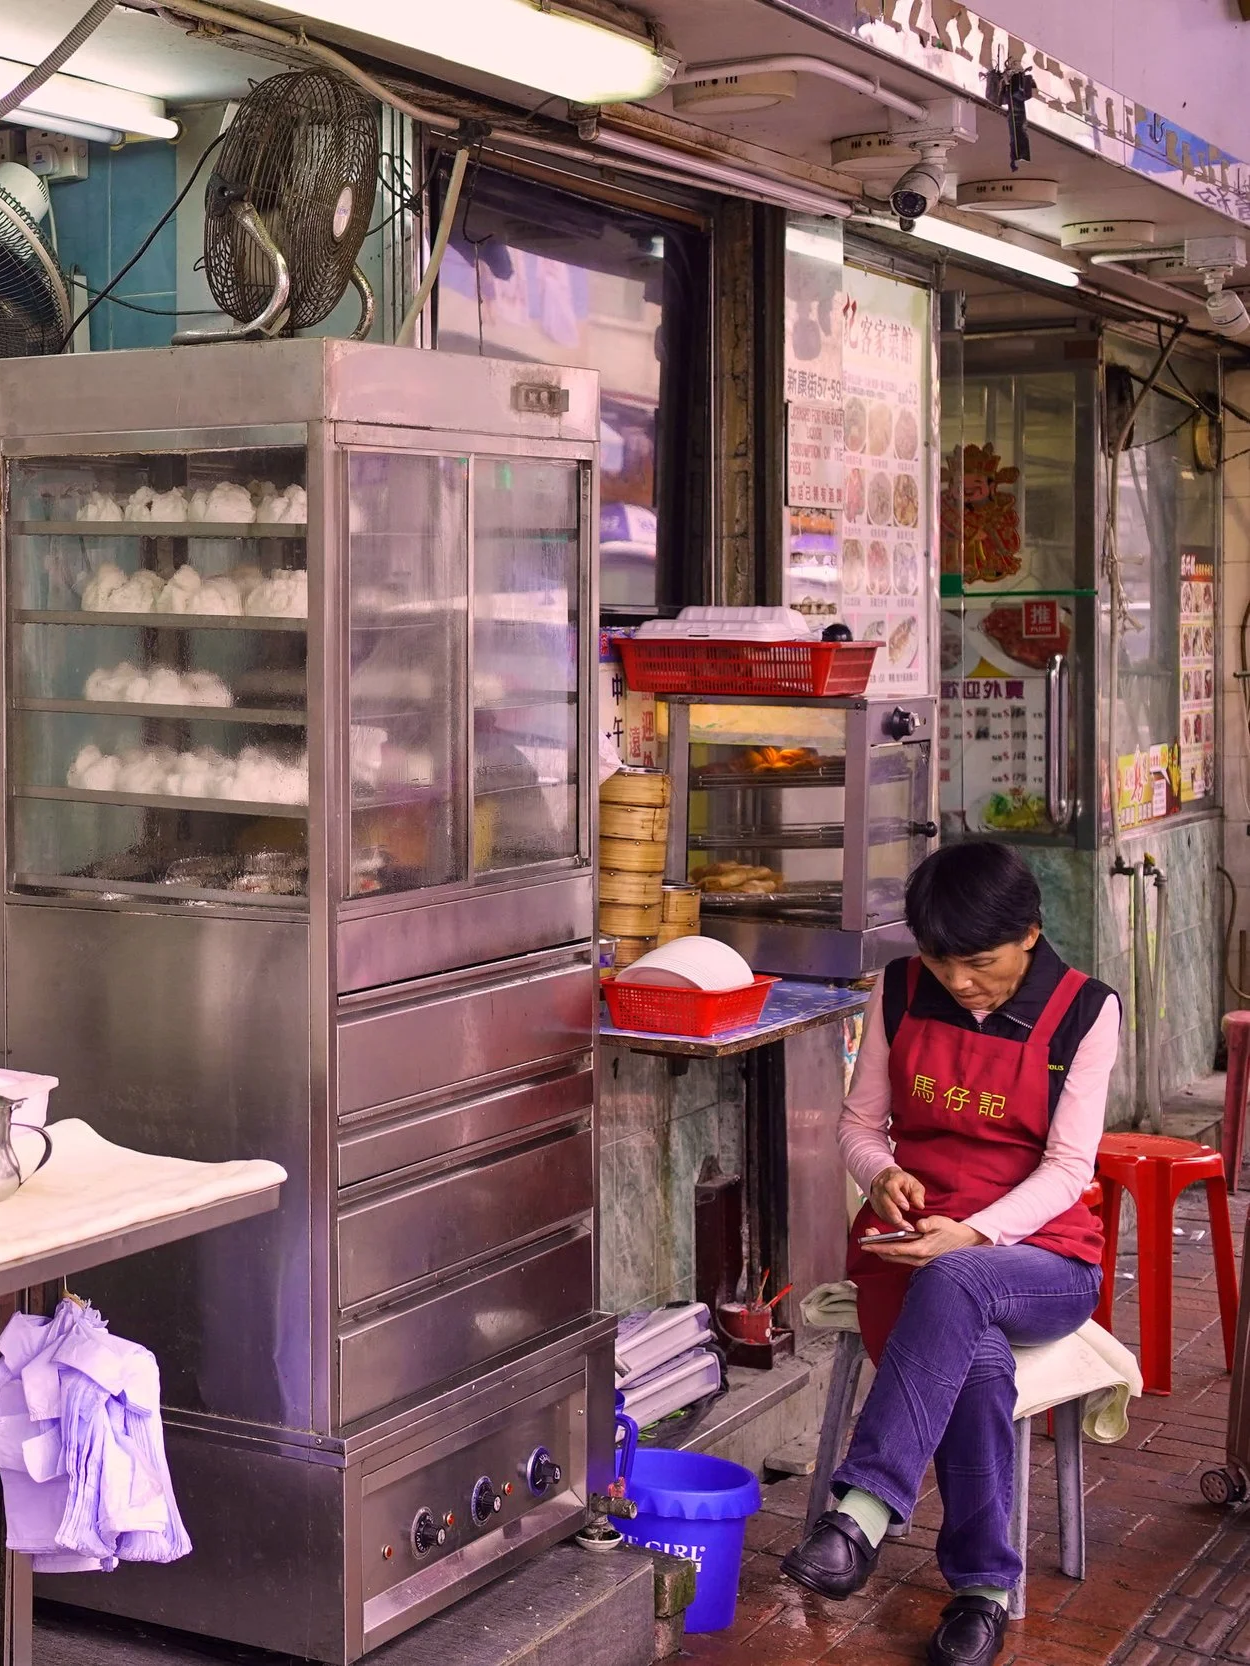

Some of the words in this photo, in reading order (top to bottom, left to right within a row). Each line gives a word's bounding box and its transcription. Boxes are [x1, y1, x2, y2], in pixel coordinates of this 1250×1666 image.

[1030, 604, 1051, 625] 推
[911, 1074, 1006, 1119] 馬仔記
